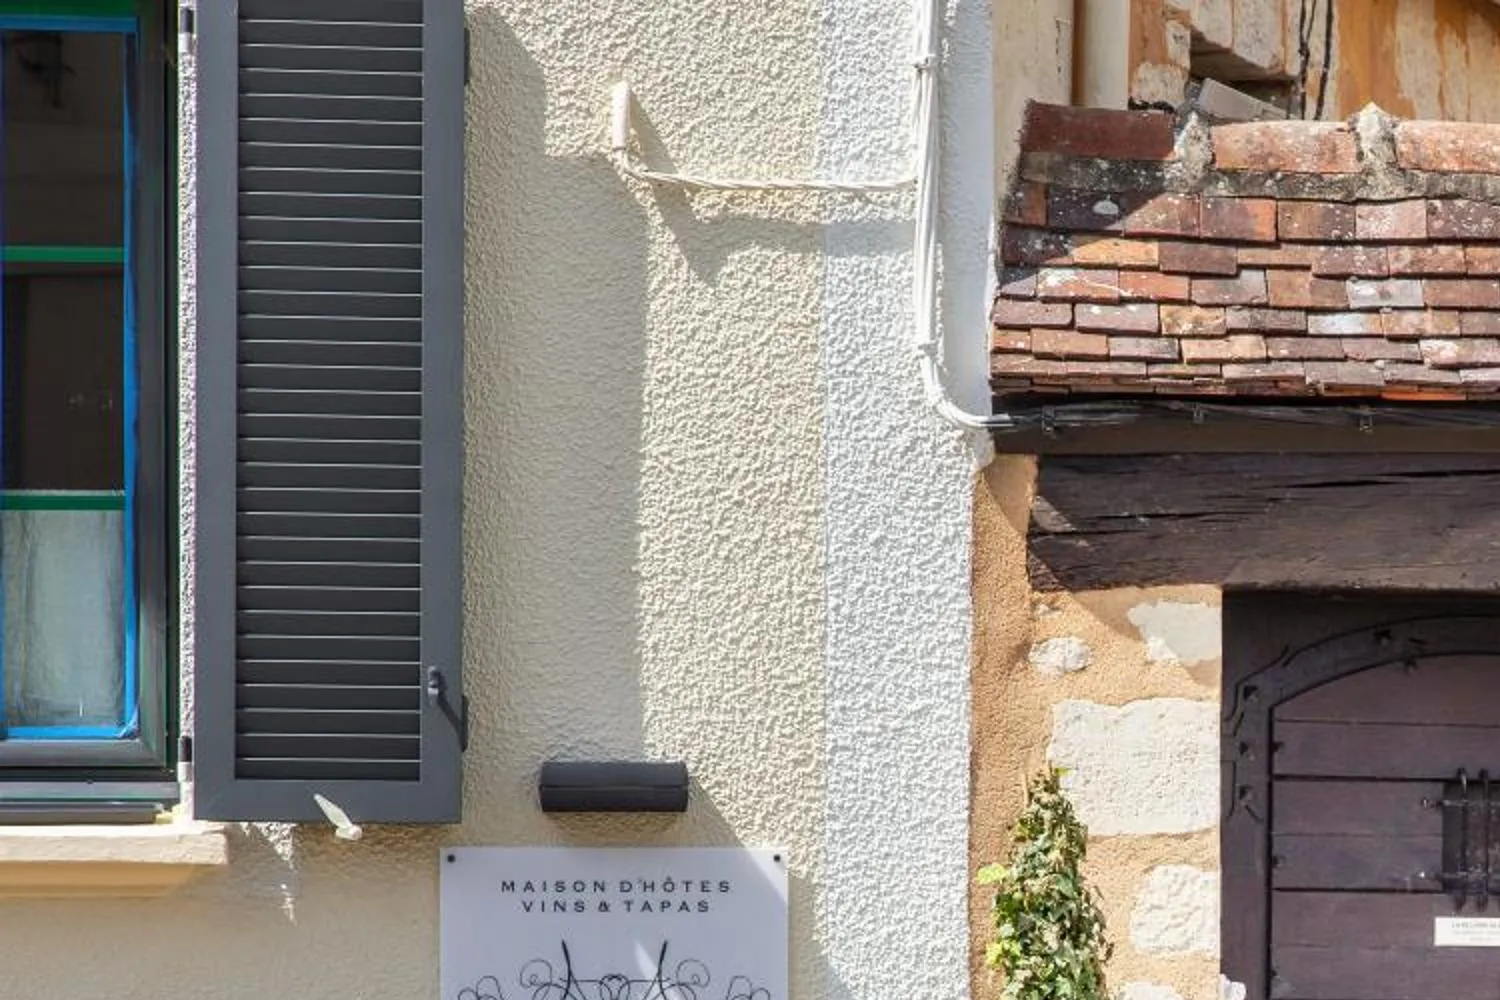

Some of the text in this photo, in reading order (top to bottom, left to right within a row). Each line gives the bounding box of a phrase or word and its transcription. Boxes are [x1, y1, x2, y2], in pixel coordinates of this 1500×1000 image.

[501, 876, 731, 893] MAISON D'HÔTES
[521, 901, 709, 913] VINS & TAPAS
